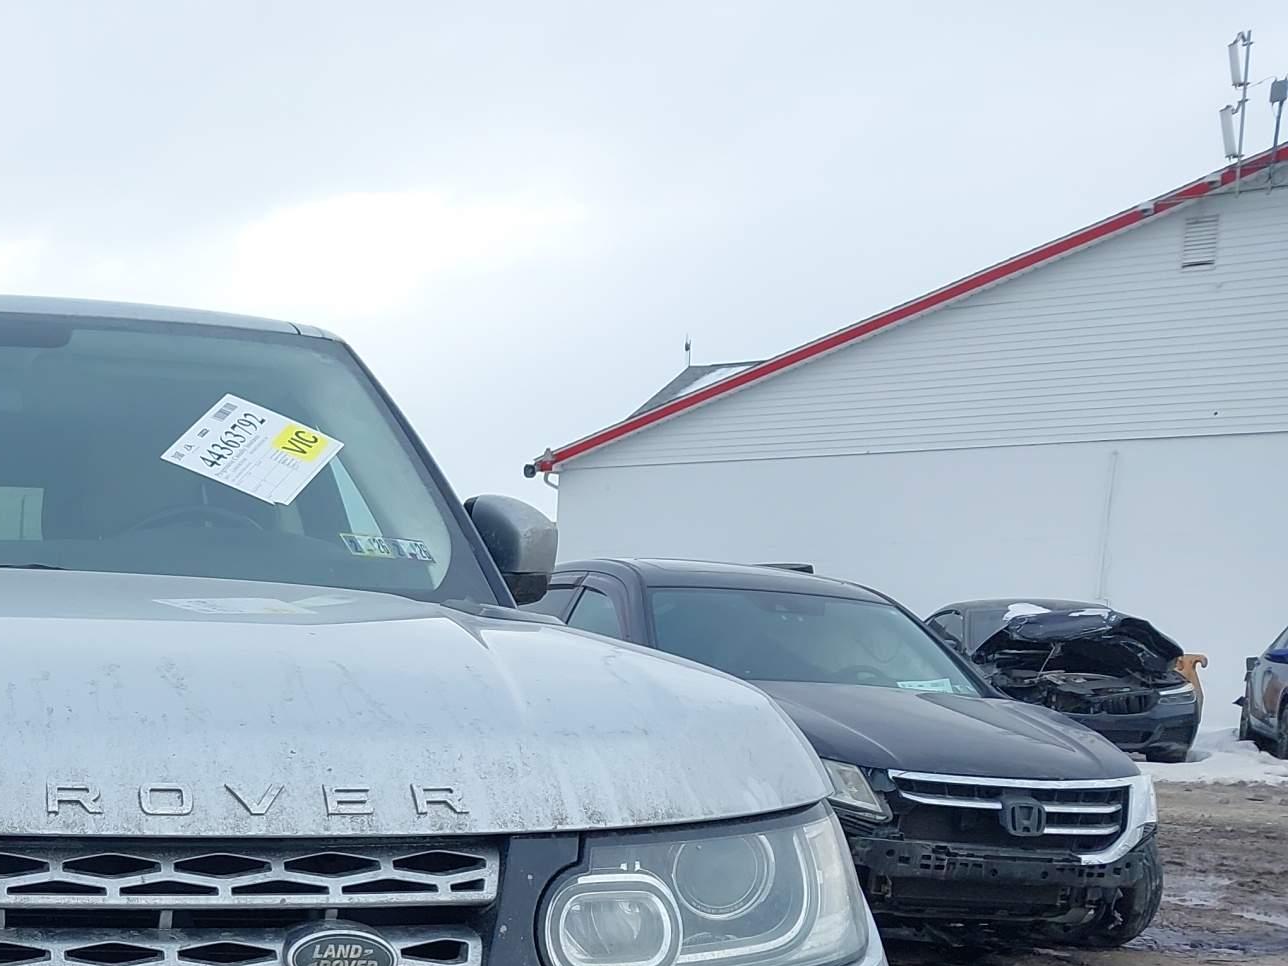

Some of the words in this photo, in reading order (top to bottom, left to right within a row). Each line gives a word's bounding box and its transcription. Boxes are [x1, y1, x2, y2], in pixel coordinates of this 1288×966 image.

[199, 412, 266, 468] 44363792
[281, 430, 319, 455] VIC
[45, 781, 470, 816] ROVER
[312, 944, 363, 958] LAND
